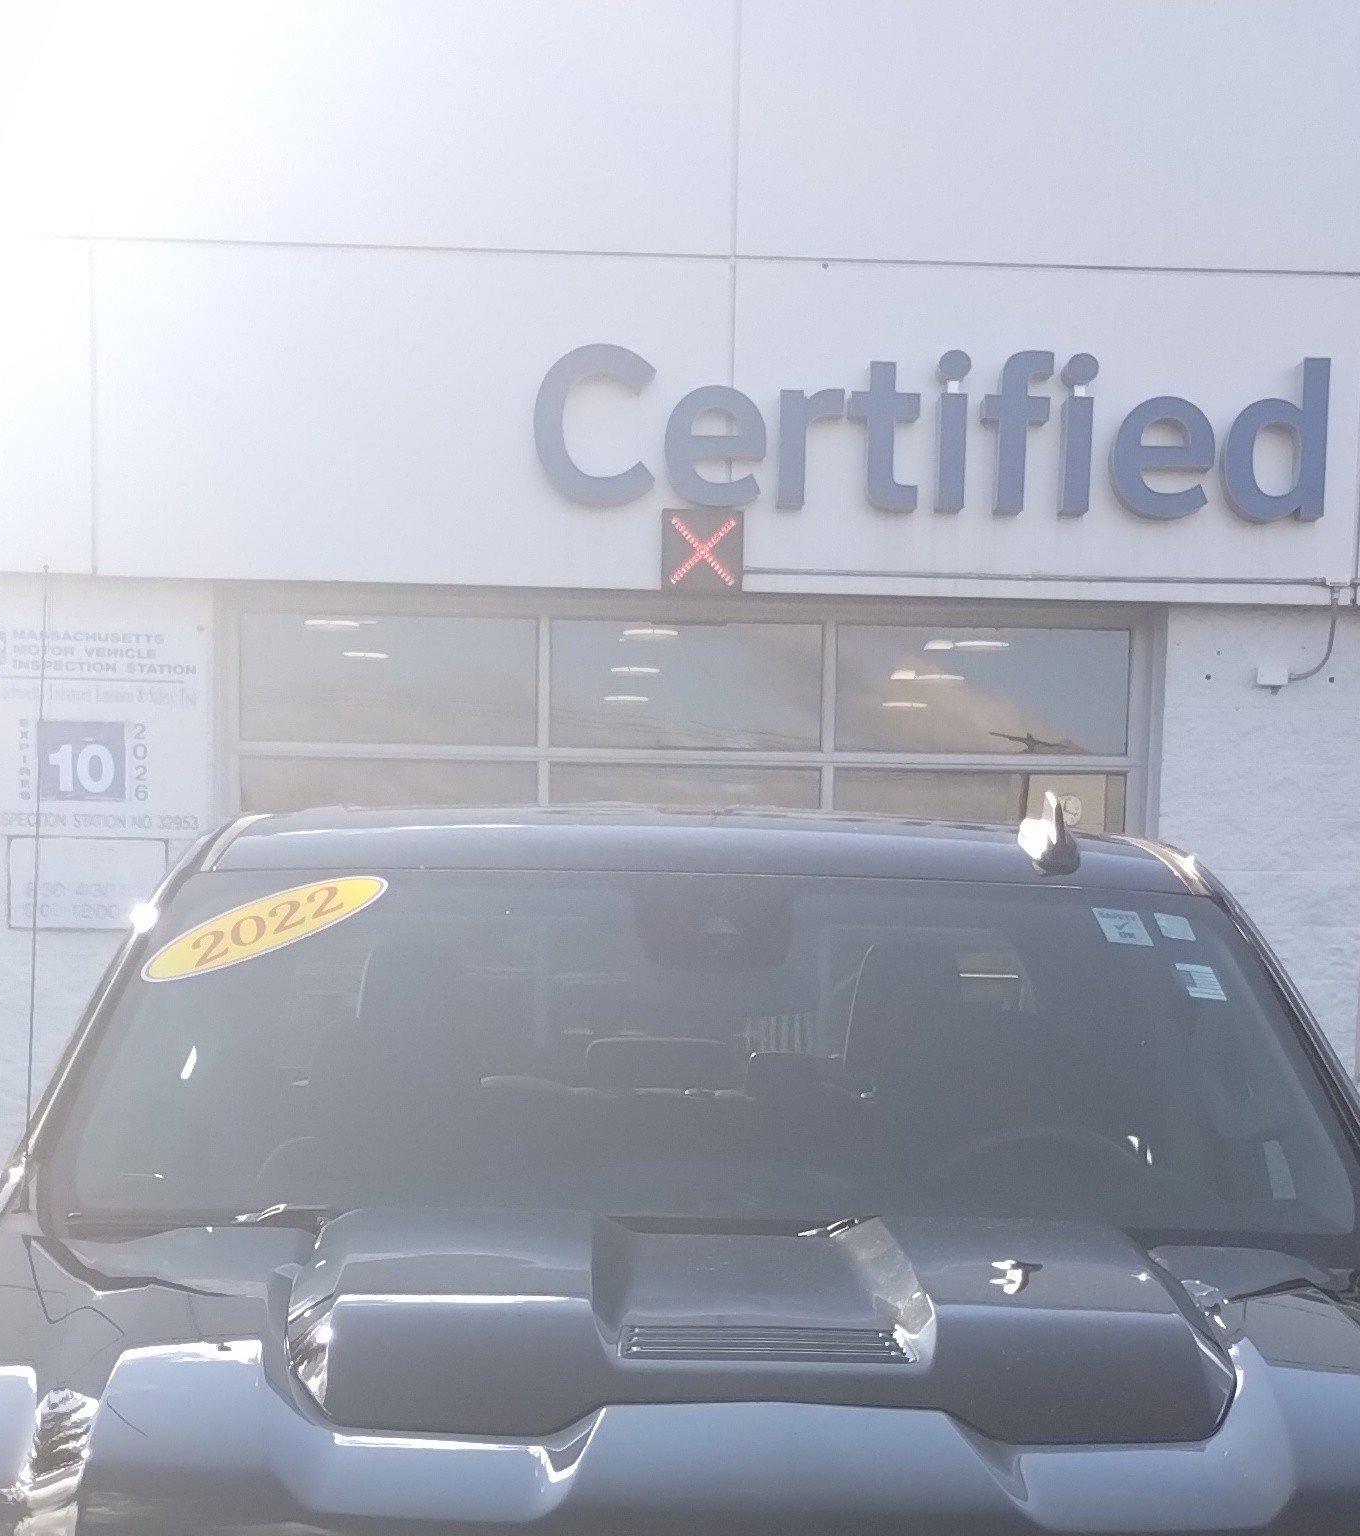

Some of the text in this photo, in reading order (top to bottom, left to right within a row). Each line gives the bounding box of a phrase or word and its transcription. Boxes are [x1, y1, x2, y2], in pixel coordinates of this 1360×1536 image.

[533, 342, 1332, 524] Certified
[12, 629, 165, 646] MASSACHUSETTS
[12, 645, 157, 660] MOTOR VEHICLE
[12, 660, 198, 676] INSPECTION STATION
[48, 743, 115, 793] 10
[133, 723, 148, 802] 2026
[73, 814, 127, 830] STATION
[157, 815, 200, 831] 32953
[192, 886, 344, 968] 2022
